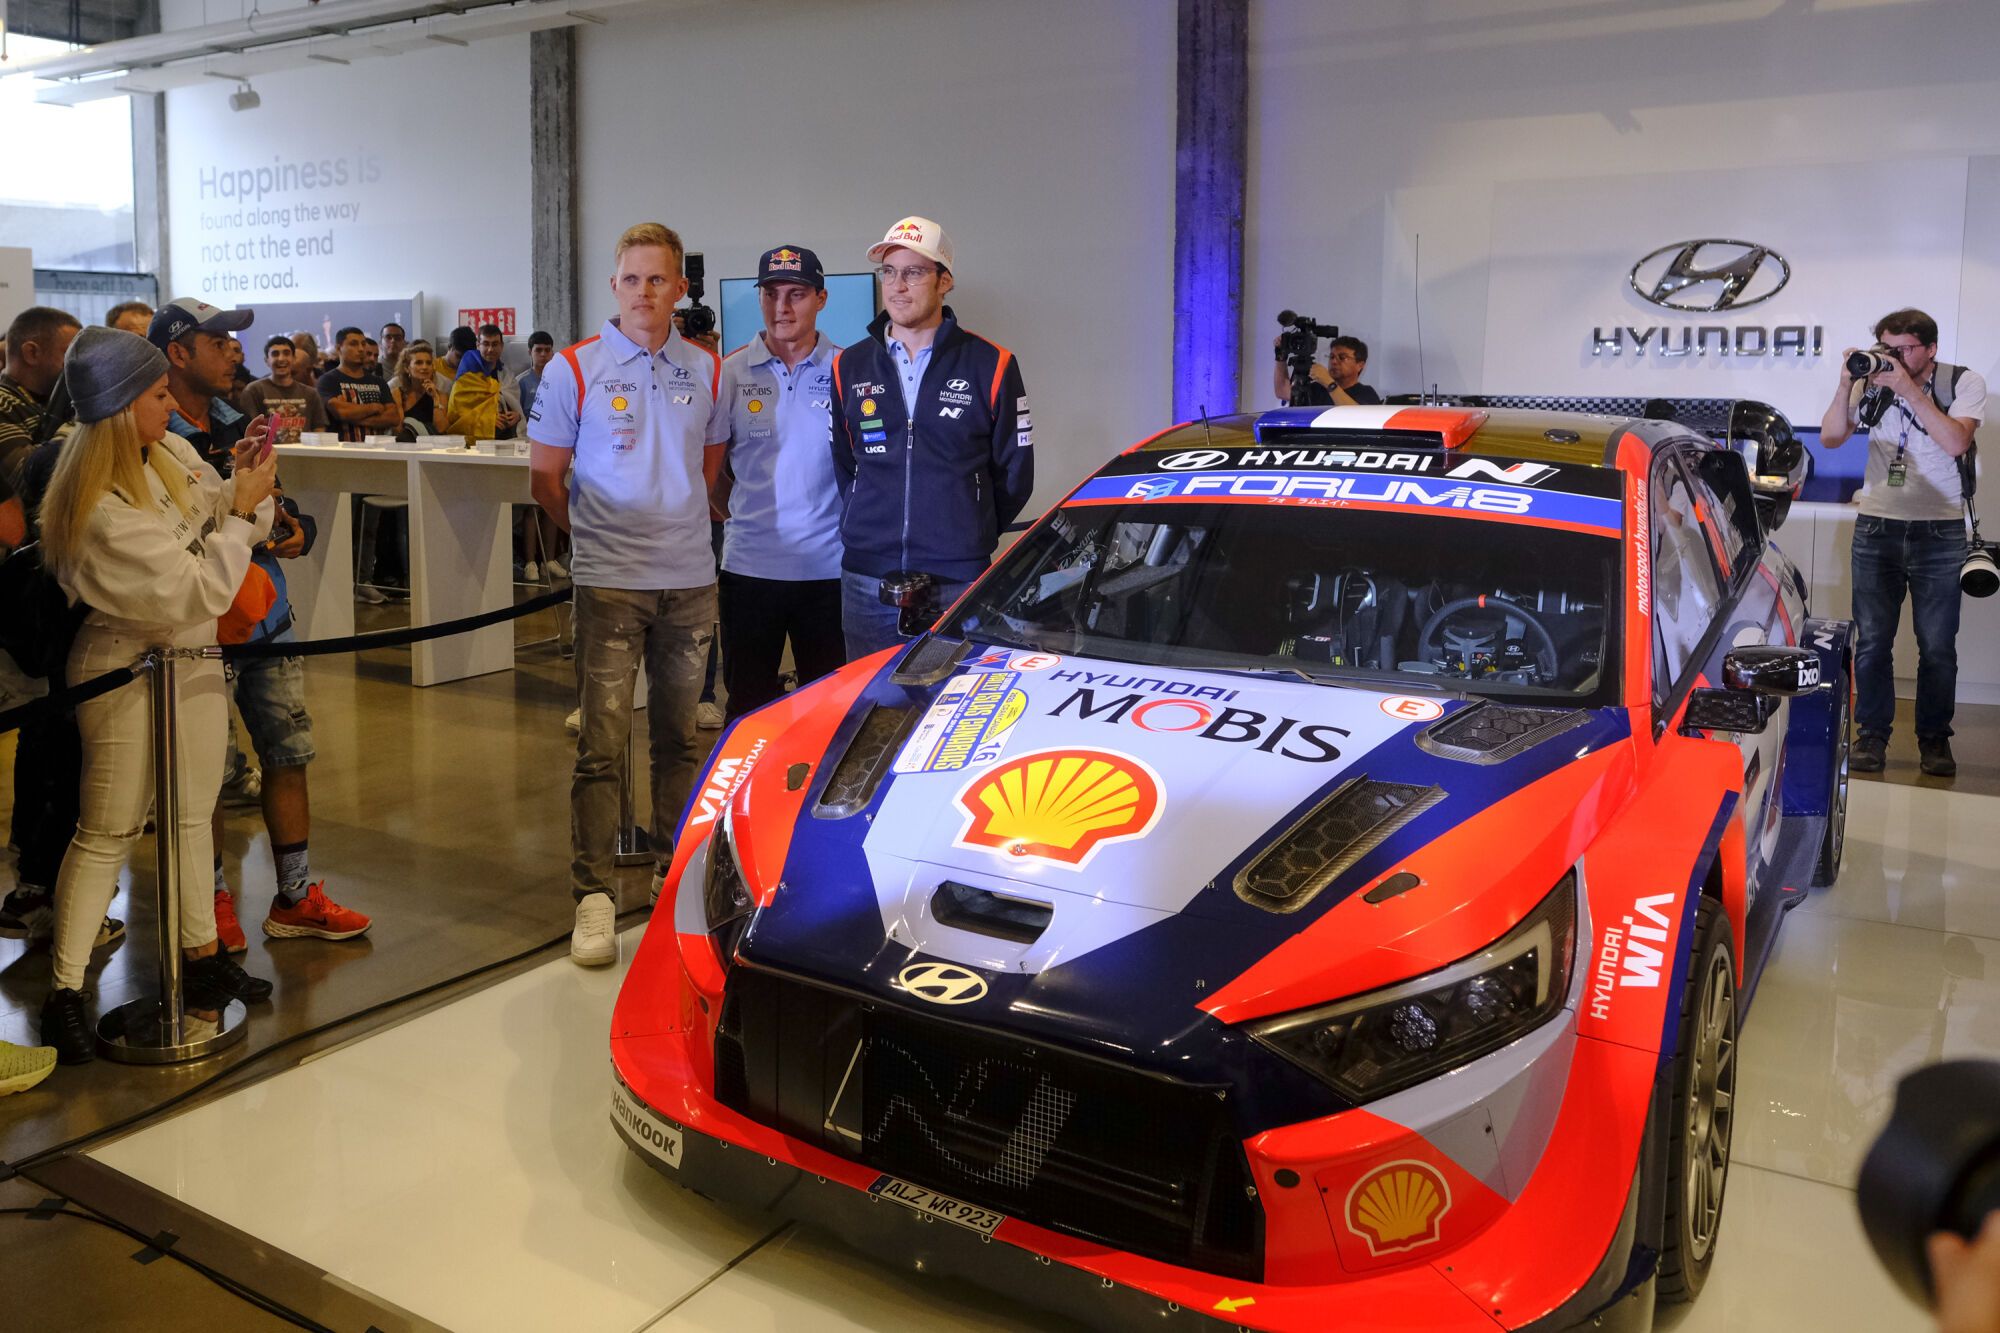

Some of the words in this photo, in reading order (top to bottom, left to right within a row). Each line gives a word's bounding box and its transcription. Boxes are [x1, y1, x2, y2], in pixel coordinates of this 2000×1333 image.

[200, 155, 349, 204] Happiness
[358, 147, 381, 184] is
[200, 209, 243, 230] found
[246, 206, 290, 228] along
[294, 203, 320, 222] the
[324, 201, 361, 223] way
[201, 240, 231, 263] not
[235, 237, 255, 261] at
[260, 233, 290, 259] the
[295, 229, 334, 256] end
[903, 232, 923, 243] Bull
[202, 271, 218, 293] of
[222, 269, 249, 292] the
[254, 266, 299, 289] road.
[768, 262, 784, 272] Red
[785, 261, 801, 271] Bull
[1592, 326, 1824, 357] HYUNDAI
[604, 382, 637, 394] MOBIS
[742, 387, 772, 397] MOBIS
[856, 384, 885, 398] MOBIS
[940, 390, 972, 401] HYUNDAI
[865, 445, 887, 454] LKQ
[1238, 450, 1433, 471] HYUNDAI
[1181, 476, 1534, 514] FORUM8
[1633, 478, 1648, 617] motorsport.hyundai.com
[981, 673, 1008, 691] RALLY
[1048, 670, 1240, 702] HYUNDAI
[963, 691, 1004, 717] ISLAS
[1046, 688, 1351, 763] MOBIS
[933, 717, 988, 770] CANARIAS
[972, 742, 1001, 763] 16
[1590, 927, 1623, 1020] HYUNDAI
[885, 1183, 928, 1204] ALZ
[928, 1197, 956, 1215] WR
[956, 1207, 998, 1229] 923
